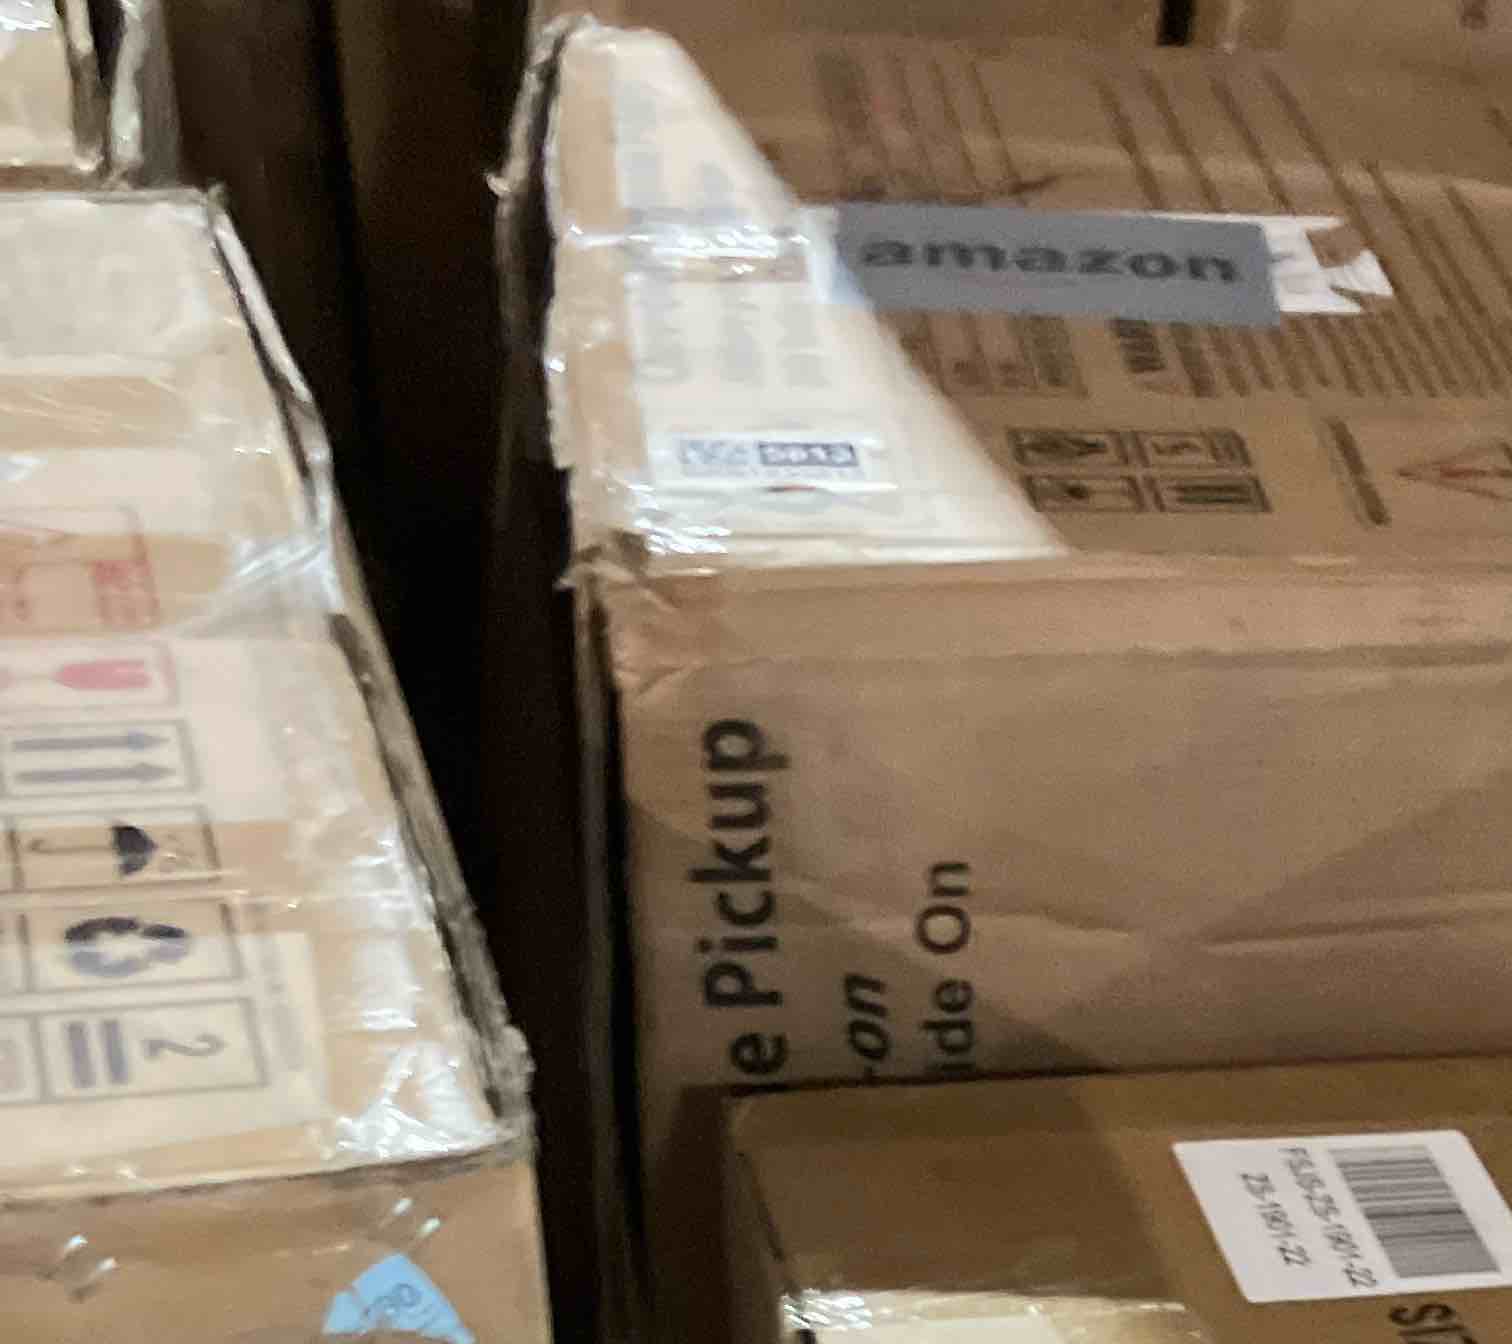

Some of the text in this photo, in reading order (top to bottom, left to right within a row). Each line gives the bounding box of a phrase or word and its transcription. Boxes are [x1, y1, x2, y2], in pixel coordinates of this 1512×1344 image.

[859, 239, 1242, 284] amazon
[688, 718, 790, 1008] Pickup
[914, 861, 972, 954] On
